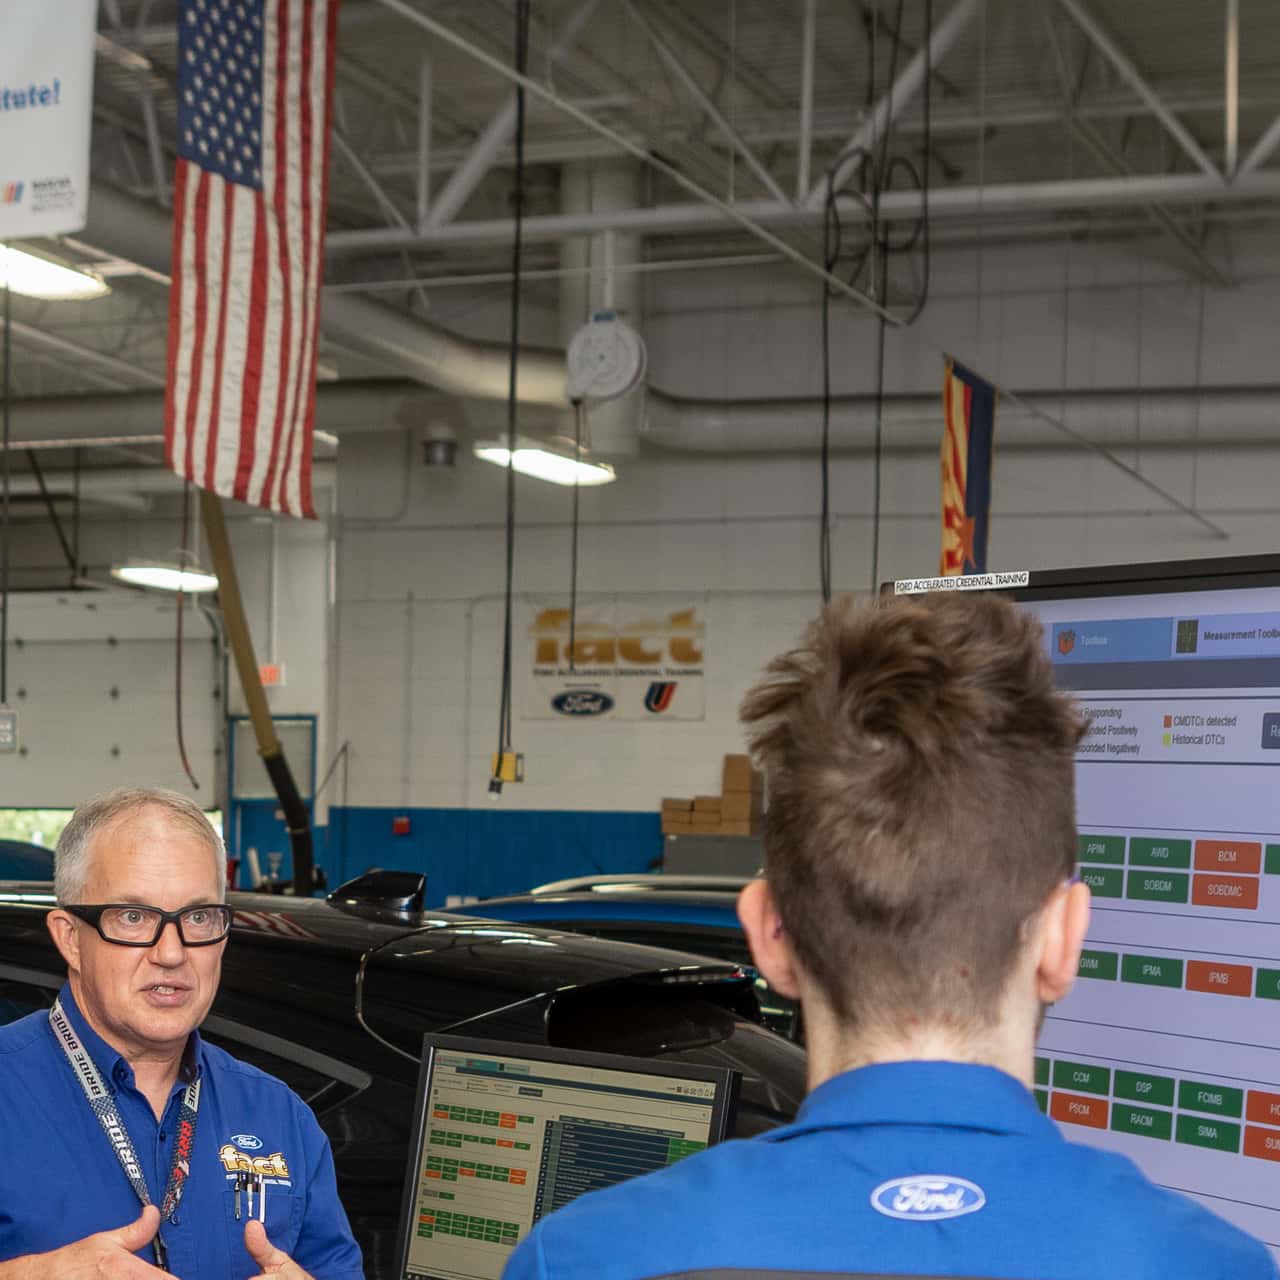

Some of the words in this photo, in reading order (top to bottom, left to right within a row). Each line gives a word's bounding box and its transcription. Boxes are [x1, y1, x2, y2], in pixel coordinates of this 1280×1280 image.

[1202, 629, 1256, 641] Measurement
[1172, 714, 1204, 727] CMDTCs
[1205, 715, 1237, 727] detected
[1170, 733, 1204, 745] Historical
[1204, 733, 1225, 745] DTCs
[53, 1014, 78, 1050] BRIDE
[74, 1052, 102, 1096] BRIDE
[102, 1113, 141, 1178] BRIDE
[218, 1145, 289, 1178] fact
[891, 1180, 968, 1213] Ford
